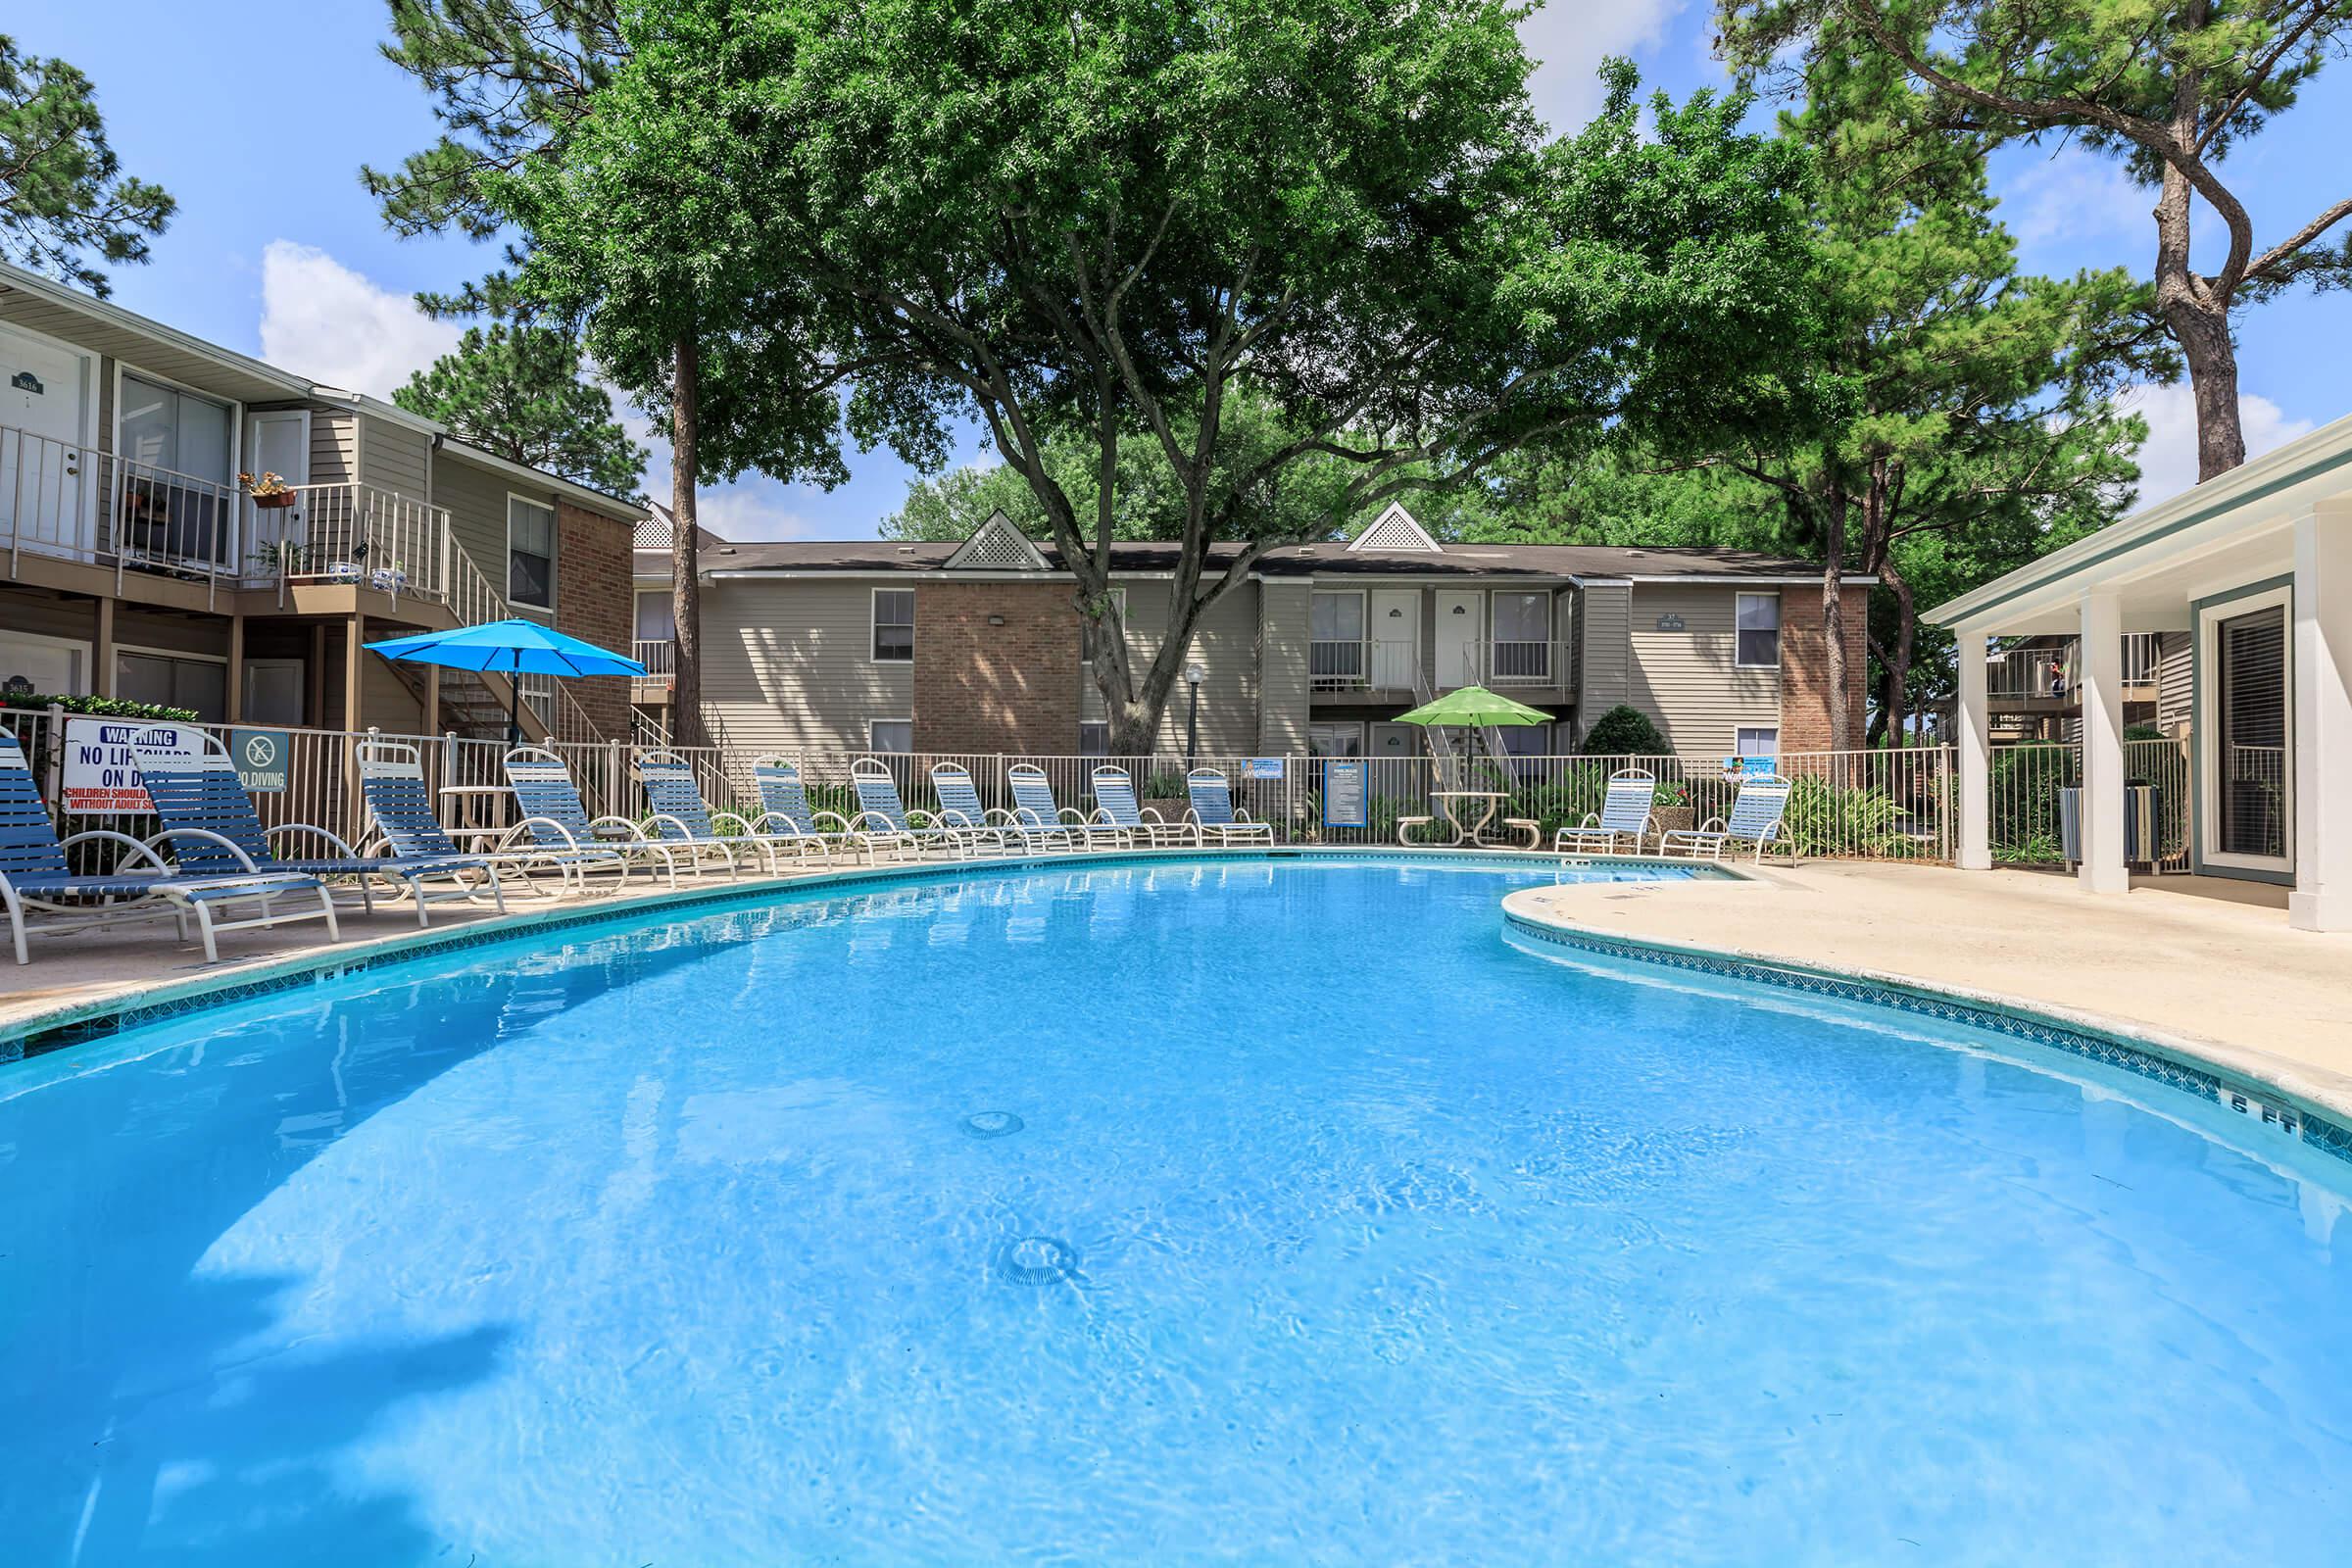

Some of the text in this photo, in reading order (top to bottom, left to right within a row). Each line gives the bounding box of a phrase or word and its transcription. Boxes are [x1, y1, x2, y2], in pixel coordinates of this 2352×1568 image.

[19, 379, 37, 392] 3616
[80, 747, 103, 764] NO
[102, 768, 124, 787] ON
[251, 772, 284, 787] DIVING
[65, 787, 111, 799] CHILDREN
[112, 789, 146, 800] SHOULD
[71, 800, 114, 809] WITHOUT
[114, 800, 142, 809] ADULT
